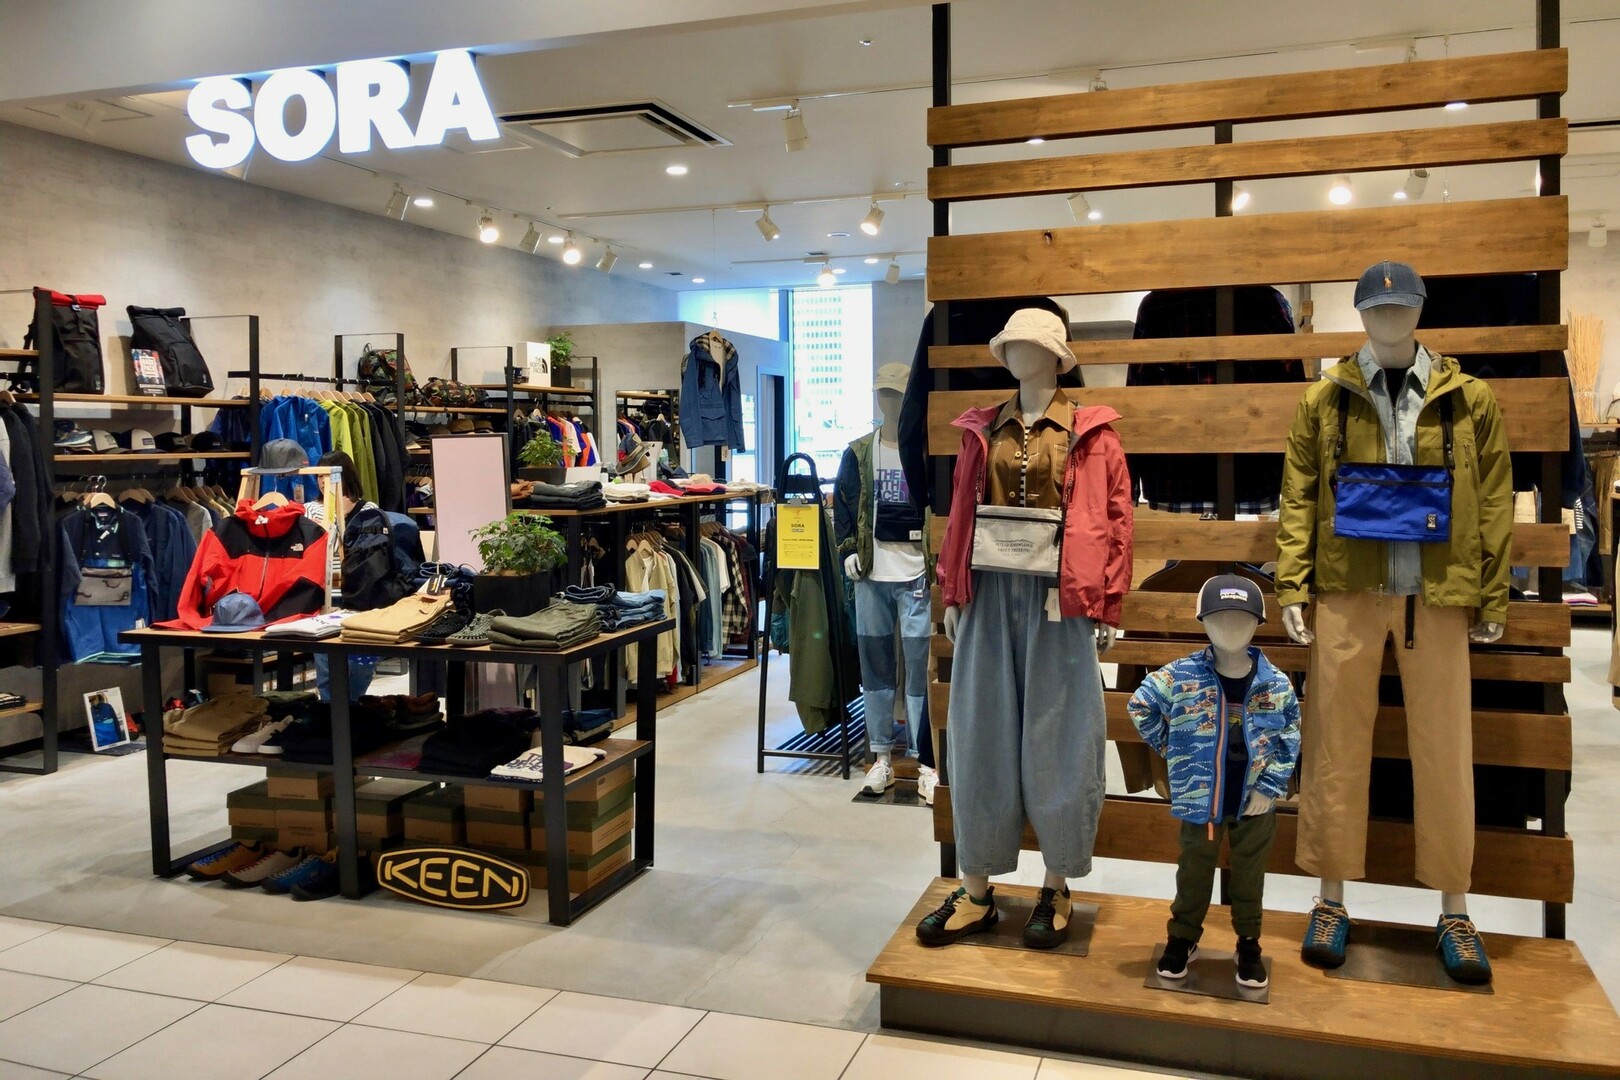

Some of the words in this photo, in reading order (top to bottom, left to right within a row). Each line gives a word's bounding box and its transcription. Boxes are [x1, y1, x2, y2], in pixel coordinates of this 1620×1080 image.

[185, 49, 501, 169] SORA
[874, 480, 900, 490] RTH
[876, 469, 901, 480] THE
[384, 857, 520, 899] KEEN
